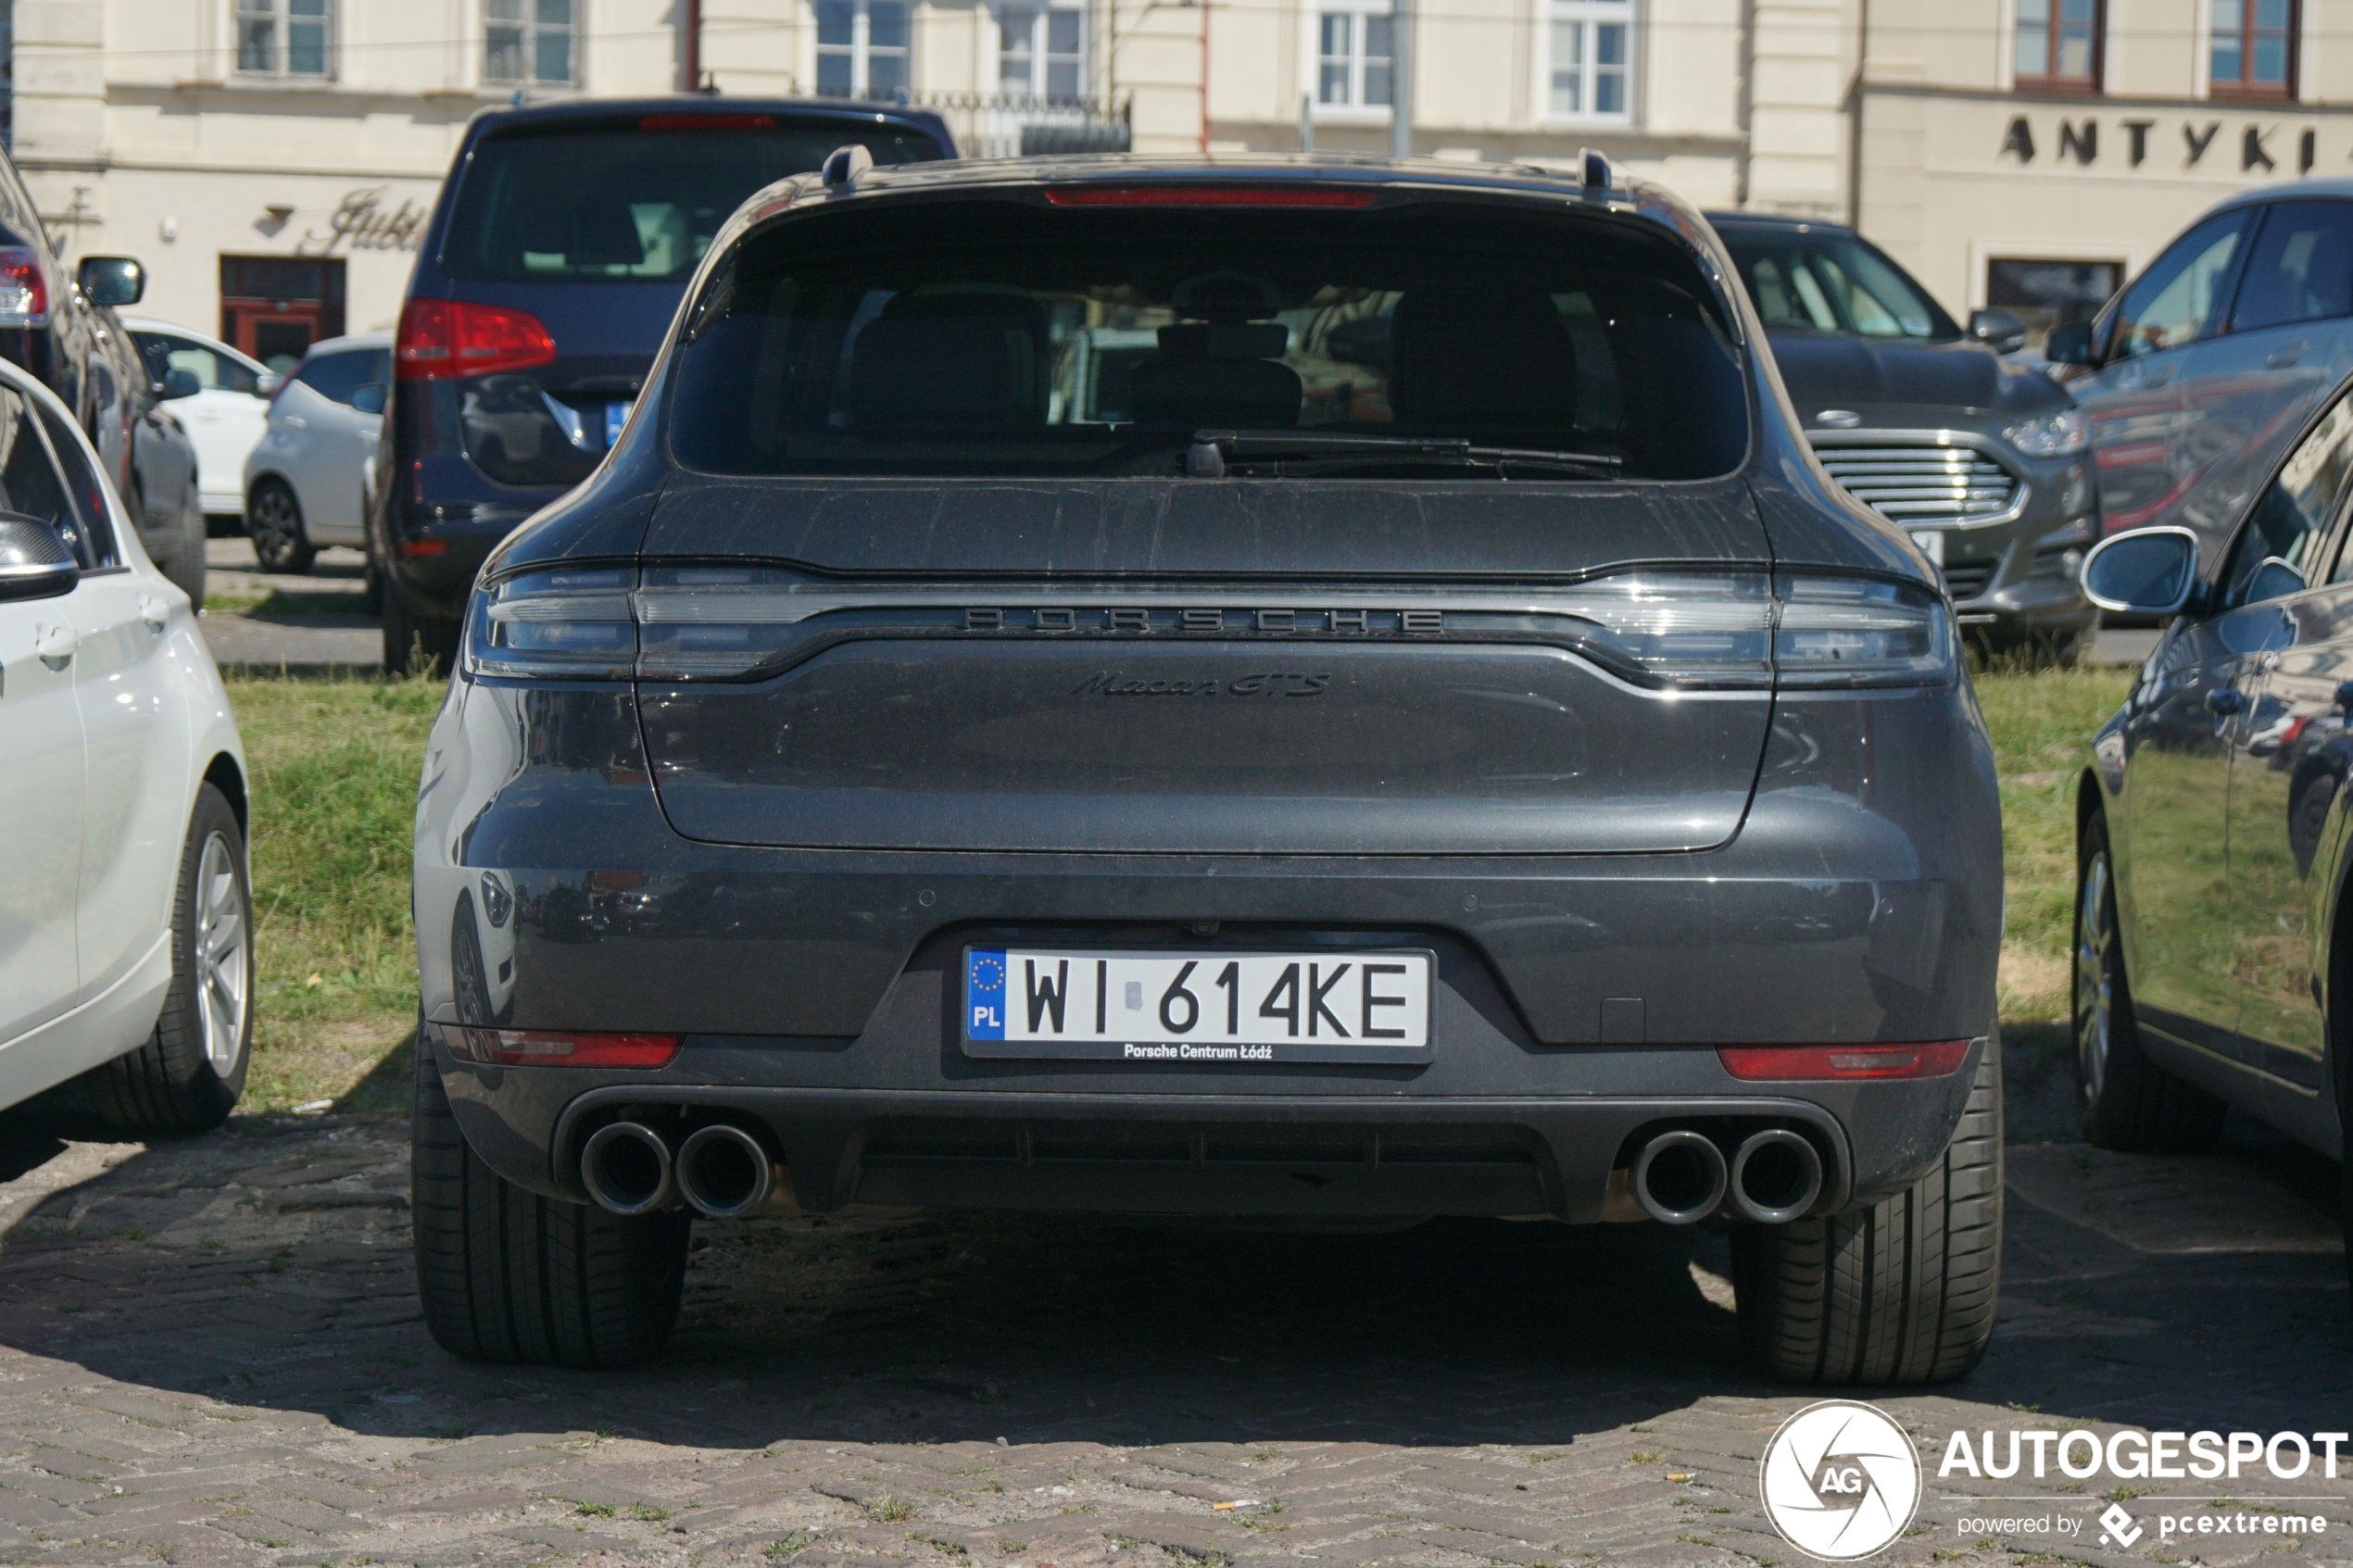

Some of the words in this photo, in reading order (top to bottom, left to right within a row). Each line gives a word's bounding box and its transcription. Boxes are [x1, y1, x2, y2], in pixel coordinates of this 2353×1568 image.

[2000, 113, 2319, 176] ANTYKI
[964, 608, 1442, 633] PORSCHE
[1070, 671, 1218, 696] Macan
[1228, 672, 1332, 696] GTS
[1025, 959, 1105, 1034] WI
[1159, 960, 1407, 1038] 614KE
[974, 1006, 1000, 1027] PL
[1124, 1043, 1177, 1059] Porsche
[1179, 1044, 1238, 1059] Centrum
[1239, 1045, 1273, 1060] Łódź
